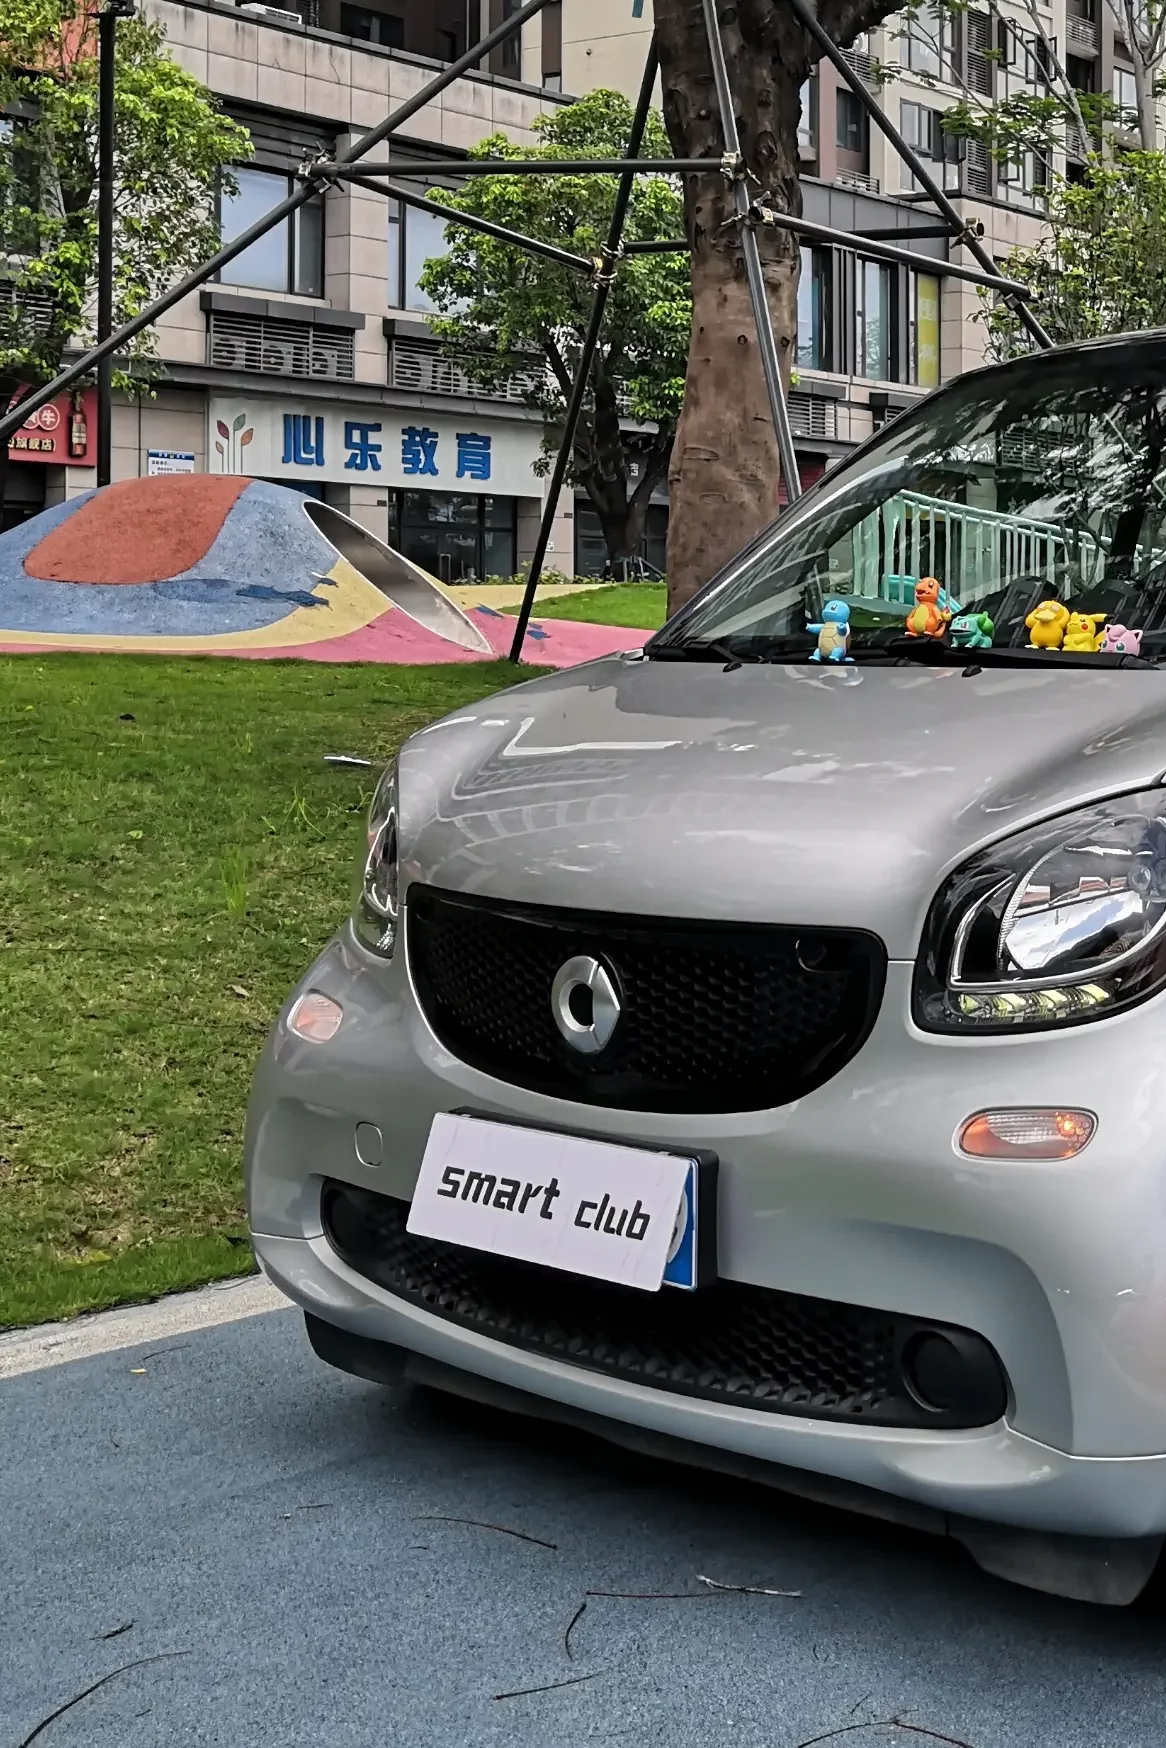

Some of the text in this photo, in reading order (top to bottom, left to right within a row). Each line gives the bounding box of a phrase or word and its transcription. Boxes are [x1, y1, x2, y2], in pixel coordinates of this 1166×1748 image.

[282, 413, 492, 481] 心乐教育
[437, 1166, 651, 1241] smart club
